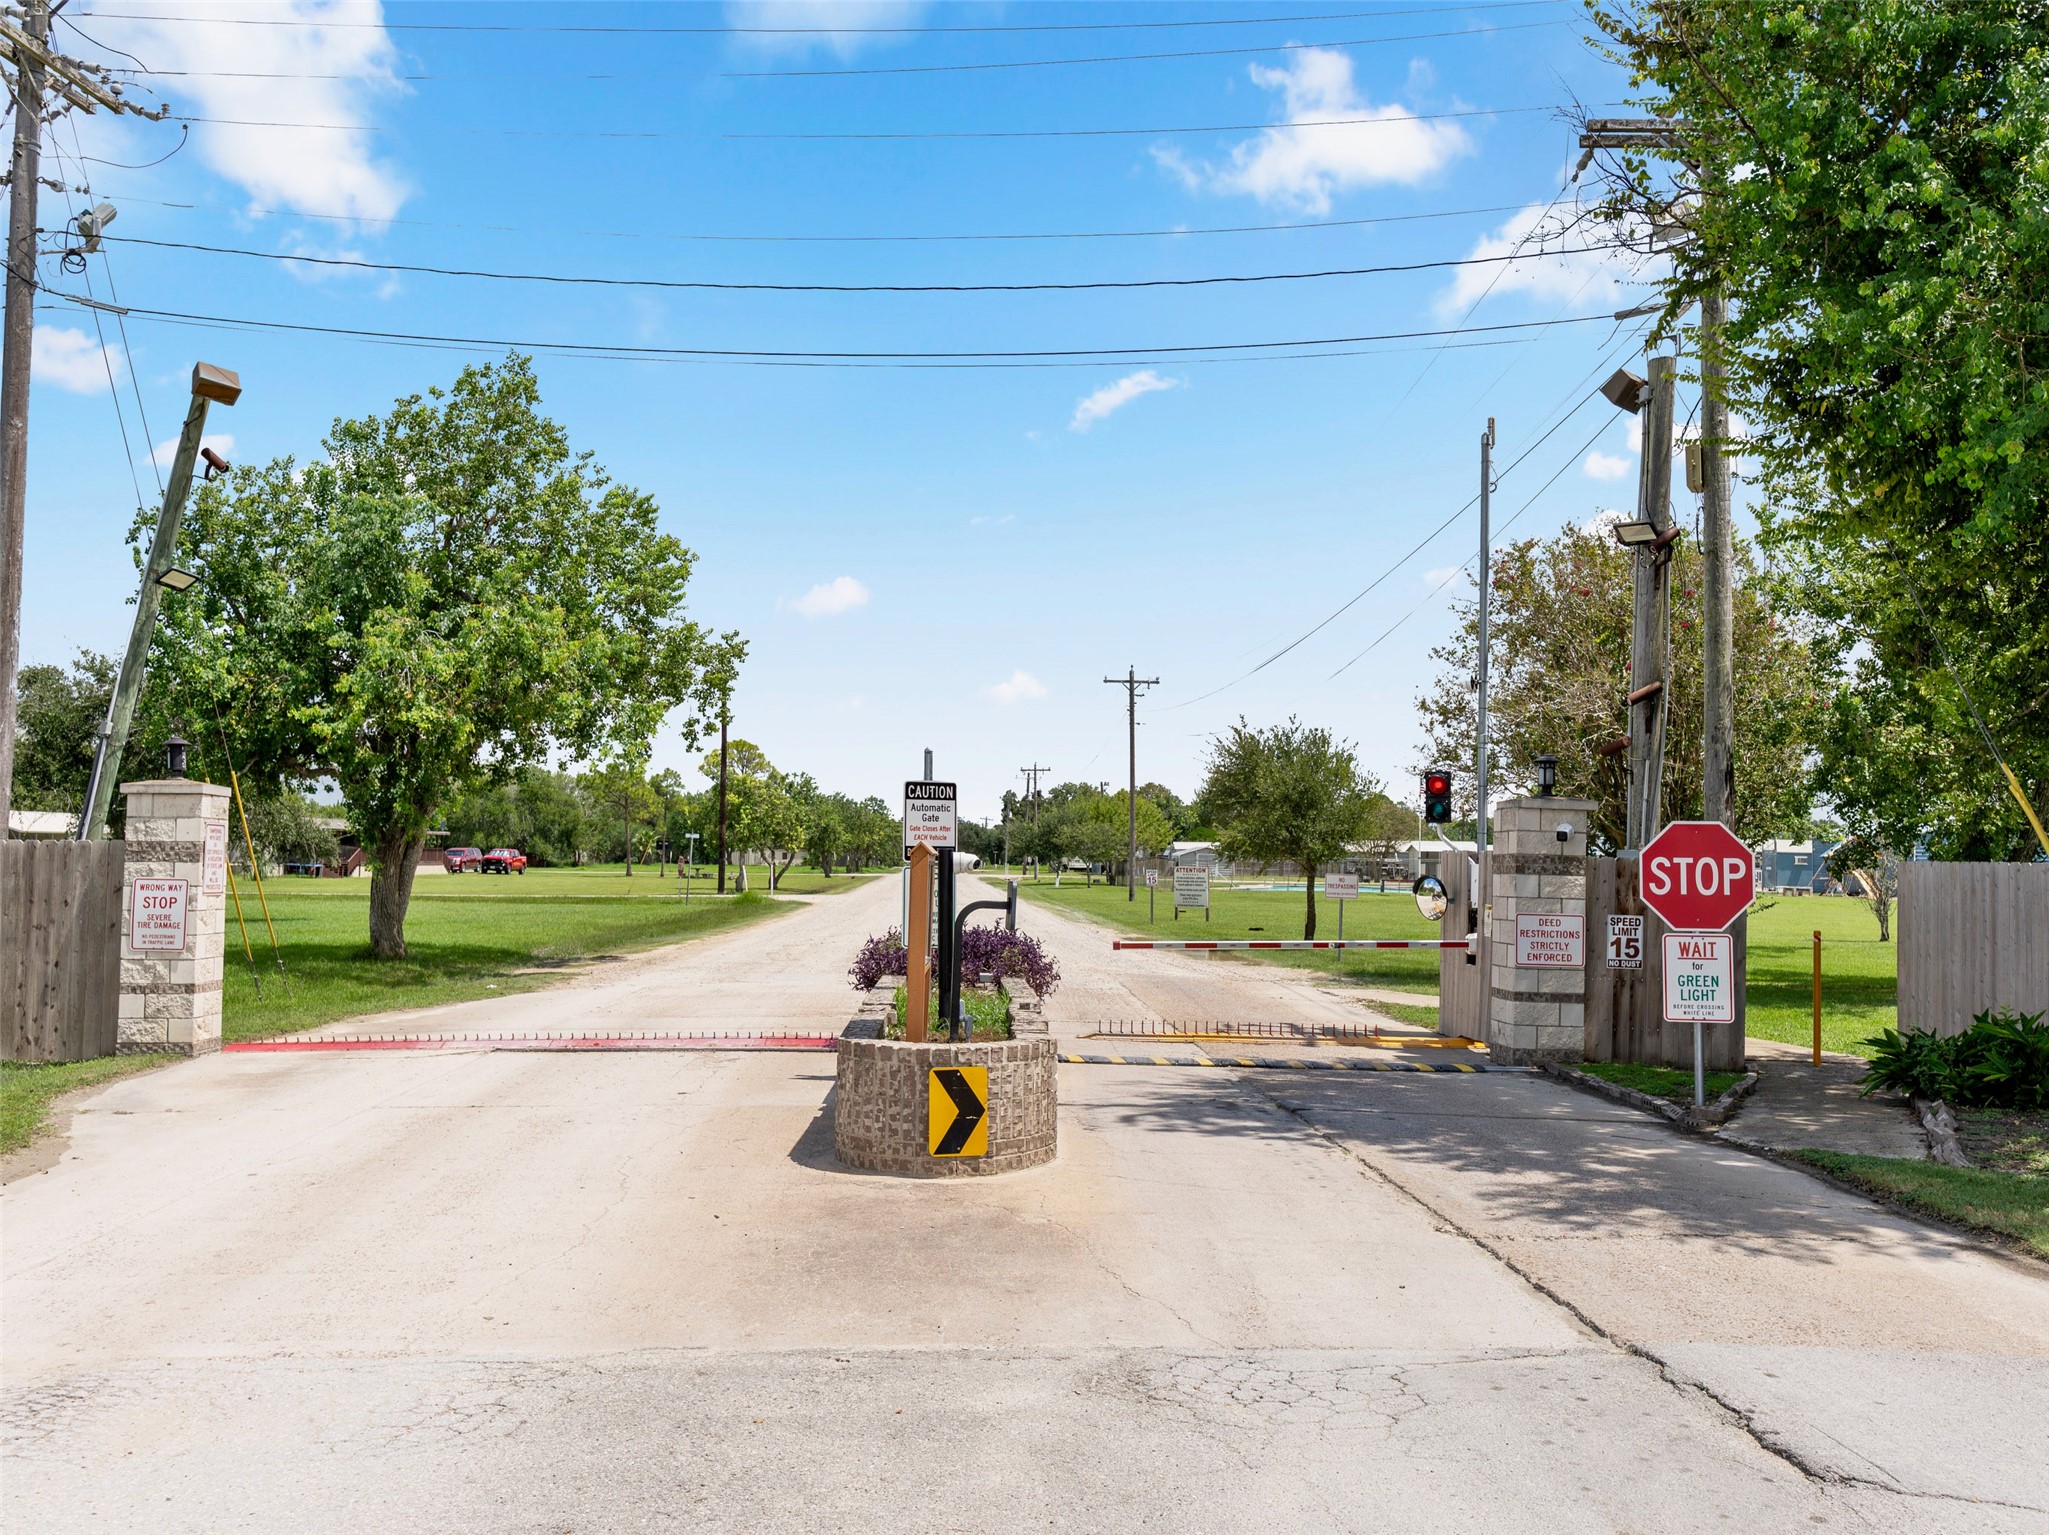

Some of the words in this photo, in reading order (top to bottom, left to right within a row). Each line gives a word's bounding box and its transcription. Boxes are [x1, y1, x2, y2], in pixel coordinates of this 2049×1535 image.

[908, 785, 953, 798] CAUTION
[910, 803, 951, 812] Automatic
[922, 814, 940, 822] Gate
[1649, 856, 1746, 896] STOP
[143, 896, 177, 909] STOP
[1539, 918, 1561, 927] DEED
[1610, 917, 1641, 926] SPEED
[1520, 930, 1580, 939] RESTRICTIONS
[1612, 927, 1638, 936] LIMIT
[1530, 942, 1569, 950] STRICTLY
[1610, 937, 1640, 958] 15
[1679, 942, 1716, 958] WAIT
[1527, 953, 1572, 962] ENFORCED
[1692, 962, 1704, 970] for
[1677, 975, 1719, 987] GREEN
[1680, 989, 1716, 1002] LIGHT
